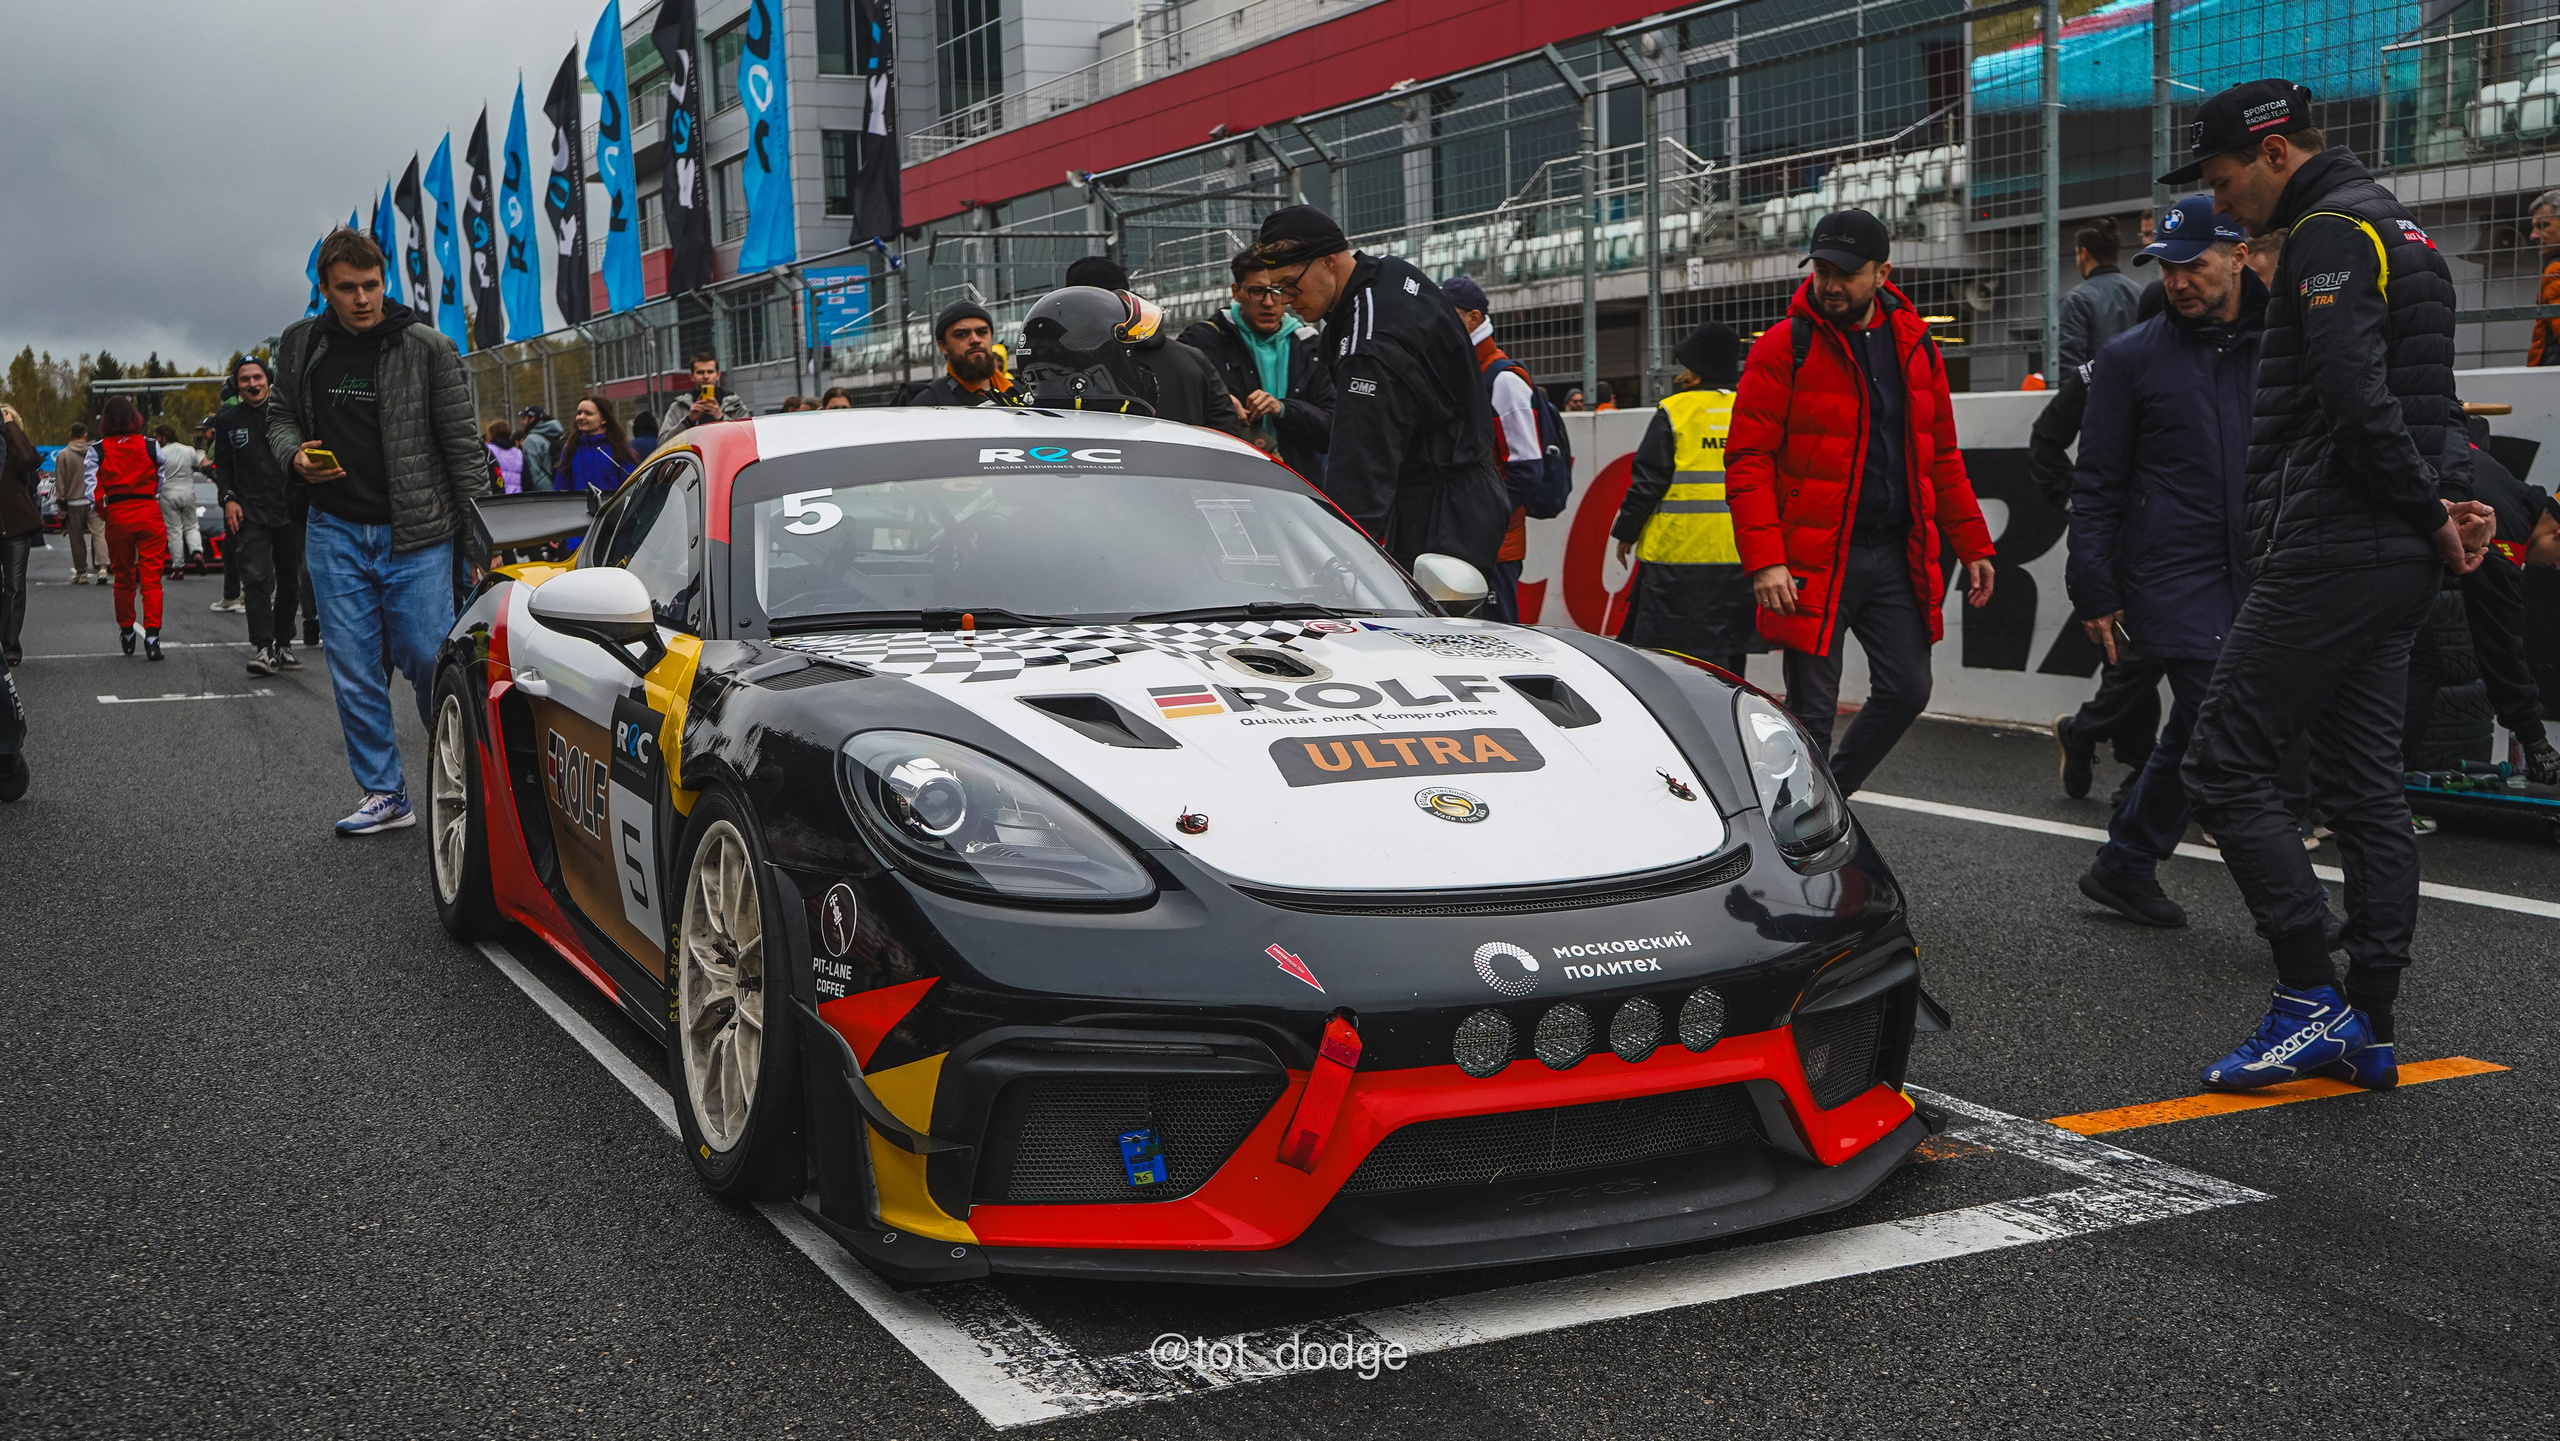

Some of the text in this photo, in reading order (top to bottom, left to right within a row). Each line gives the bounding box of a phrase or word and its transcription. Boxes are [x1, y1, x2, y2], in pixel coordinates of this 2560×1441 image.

[2243, 99, 2287, 118] SPORTCAR
[2245, 107, 2290, 125] RACING TEAM
[1349, 379, 1377, 394] OMP
[782, 487, 843, 535] 5
[1211, 675, 1504, 713] ROLF
[1240, 716, 1318, 726] Qualität
[1372, 708, 1499, 720] Kompromisse
[1304, 734, 1518, 772] ULTRA
[556, 734, 608, 841] ROLF
[1433, 810, 1456, 821] Made
[621, 819, 650, 910] 5
[812, 957, 853, 981] PIT-LANE
[816, 978, 846, 998] COFFEE
[2262, 1021, 2325, 1065] sparco
